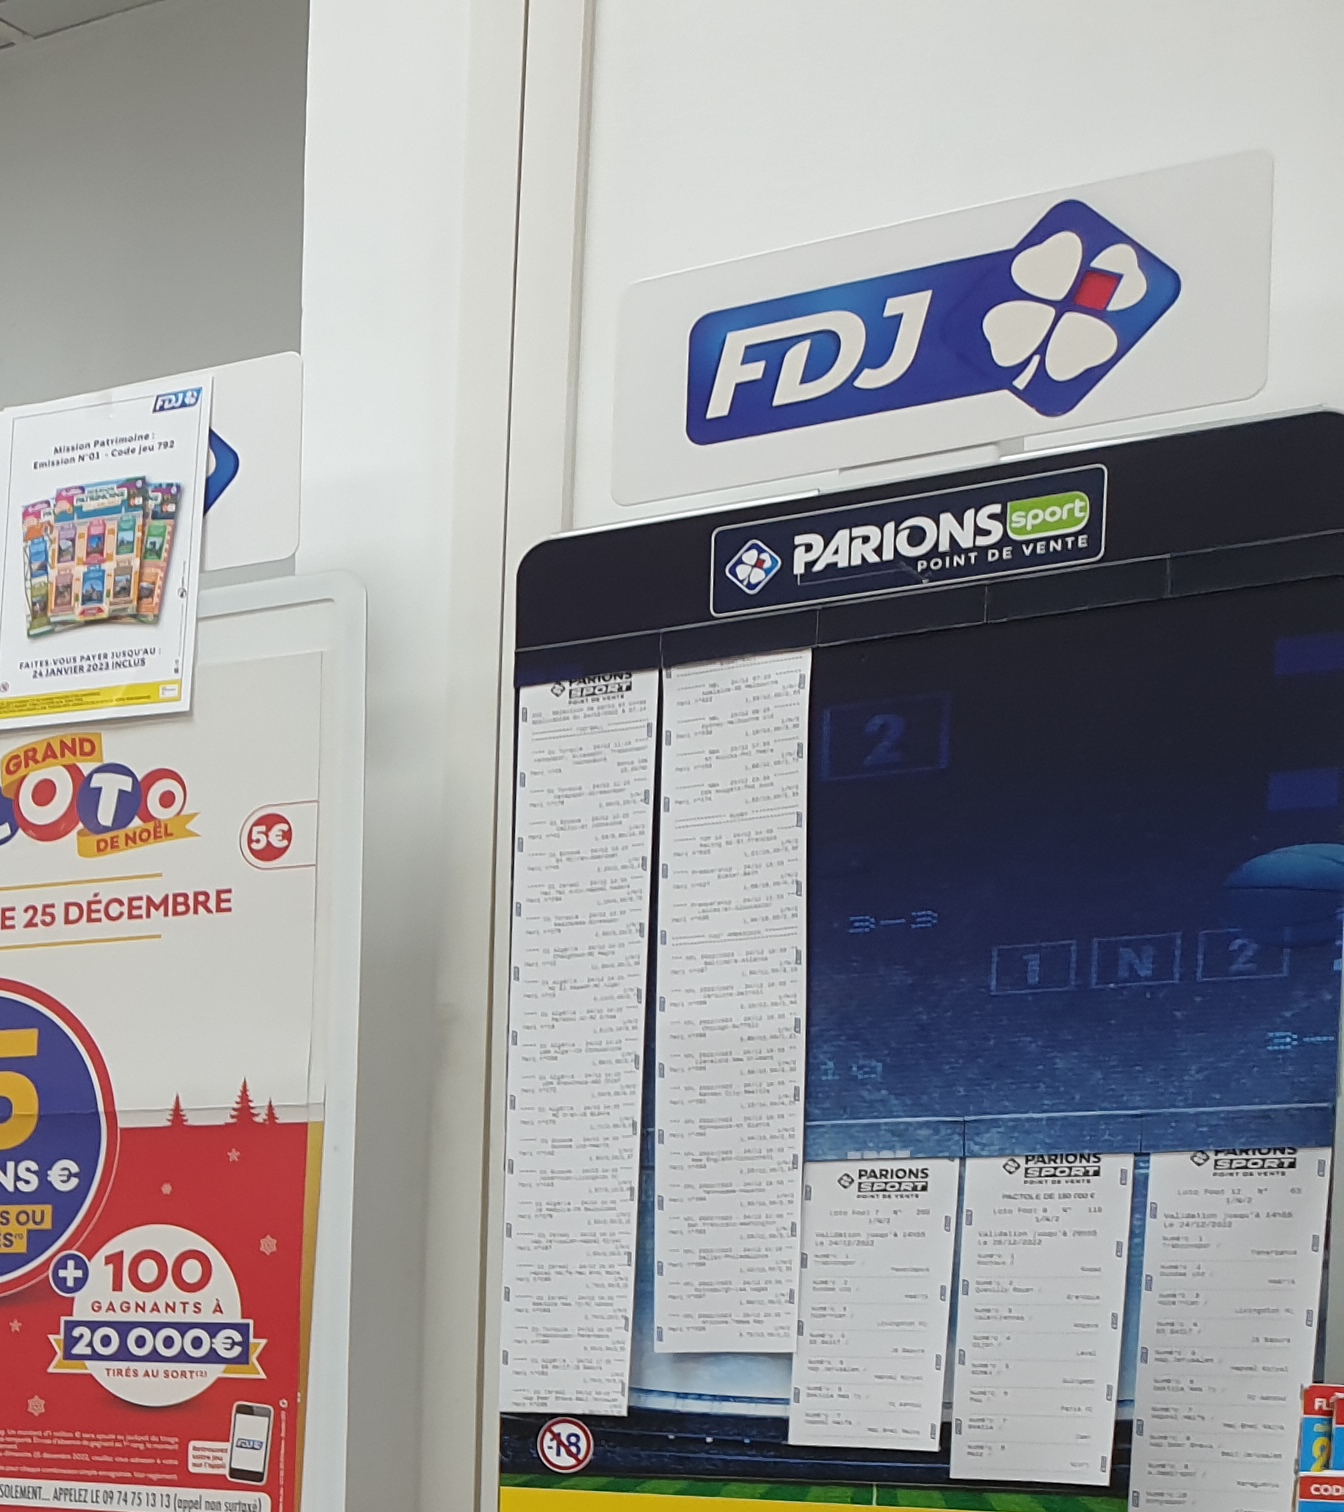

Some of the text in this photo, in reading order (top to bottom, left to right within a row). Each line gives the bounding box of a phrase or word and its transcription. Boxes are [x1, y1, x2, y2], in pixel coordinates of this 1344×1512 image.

[706, 290, 933, 420] FDJ
[154, 393, 186, 413] FDJ
[53, 432, 150, 456] Mission Patrimoine
[111, 446, 136, 459] Code
[792, 495, 1088, 576] PARIONS sport
[917, 534, 1089, 573] POINT DE VENTE
[45, 656, 146, 678] JANVIER 2023 INCLUS
[79, 652, 109, 664] PAYER
[863, 714, 907, 767] 2
[4, 737, 97, 776] GRAND
[95, 834, 121, 853] DE
[22, 902, 57, 929] 25
[63, 887, 233, 927] DÉCEMBRE
[1025, 1166, 1101, 1178] SPORT
[1214, 1157, 1297, 1170] SPORT
[858, 1167, 929, 1181] PARIONS
[858, 1181, 929, 1193] SPORT
[15, 1208, 46, 1226] OU
[103, 1249, 214, 1293] 100
[91, 1298, 204, 1316] GAGNANTS
[104, 1365, 140, 1380] TIRÉS
[53, 1485, 88, 1504] APPELEZ
